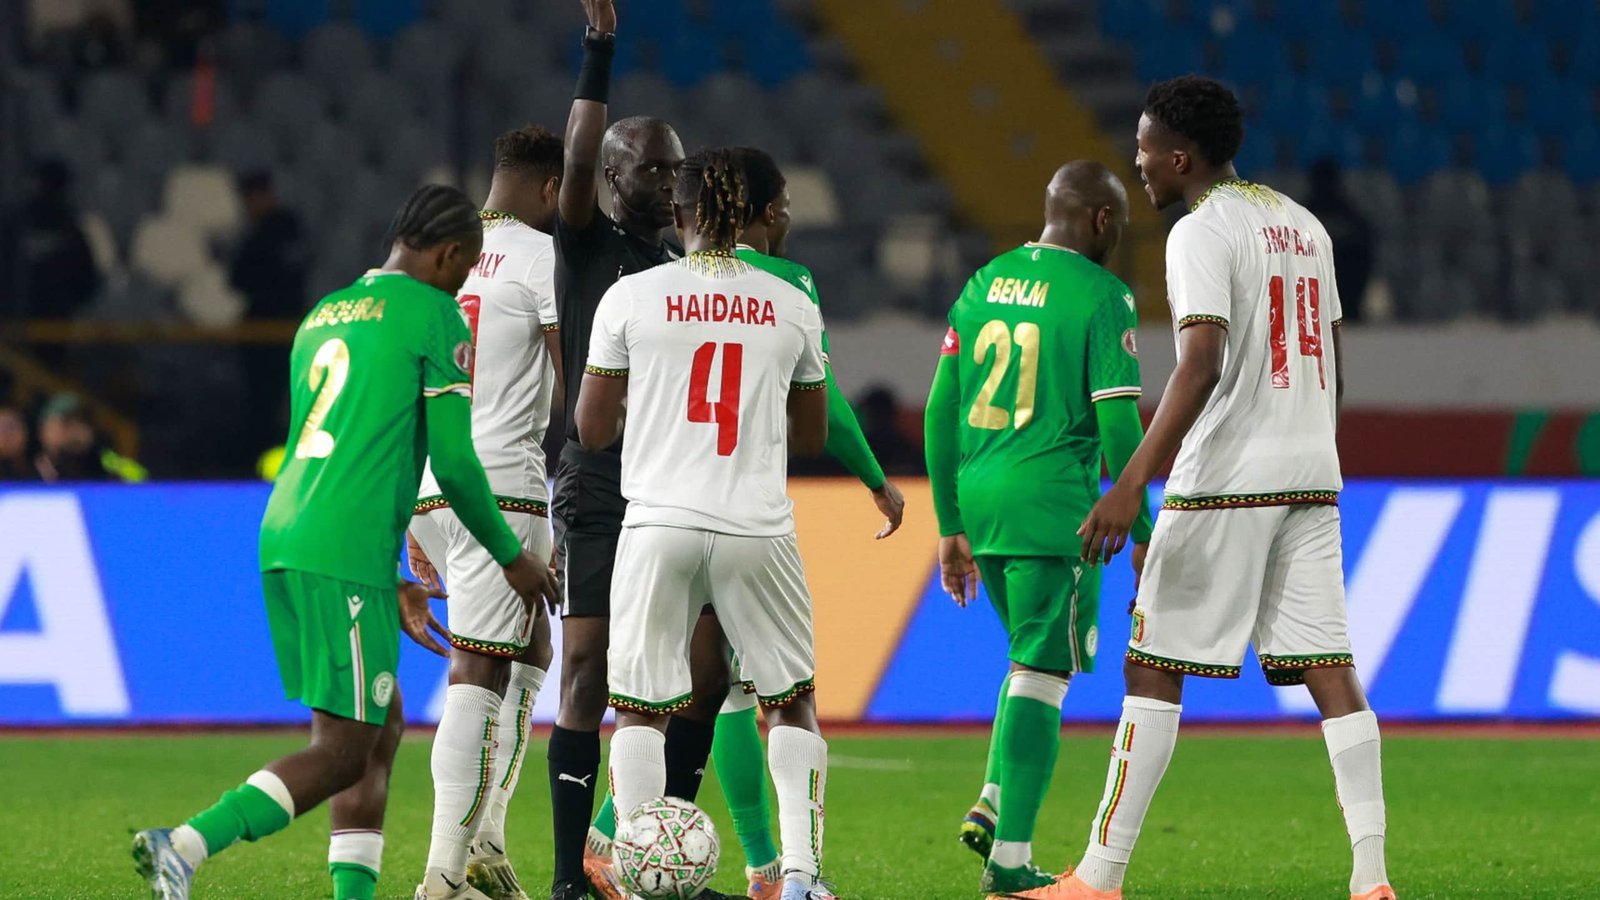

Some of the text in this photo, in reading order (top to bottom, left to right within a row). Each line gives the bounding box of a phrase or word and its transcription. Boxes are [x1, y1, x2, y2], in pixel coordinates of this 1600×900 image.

[666, 294, 776, 327] HAIDARA
[986, 277, 1049, 308] BEN.M
[1269, 275, 1325, 390] 14
[295, 338, 350, 459] 2
[687, 342, 743, 456] 4
[968, 320, 1040, 430] 21
